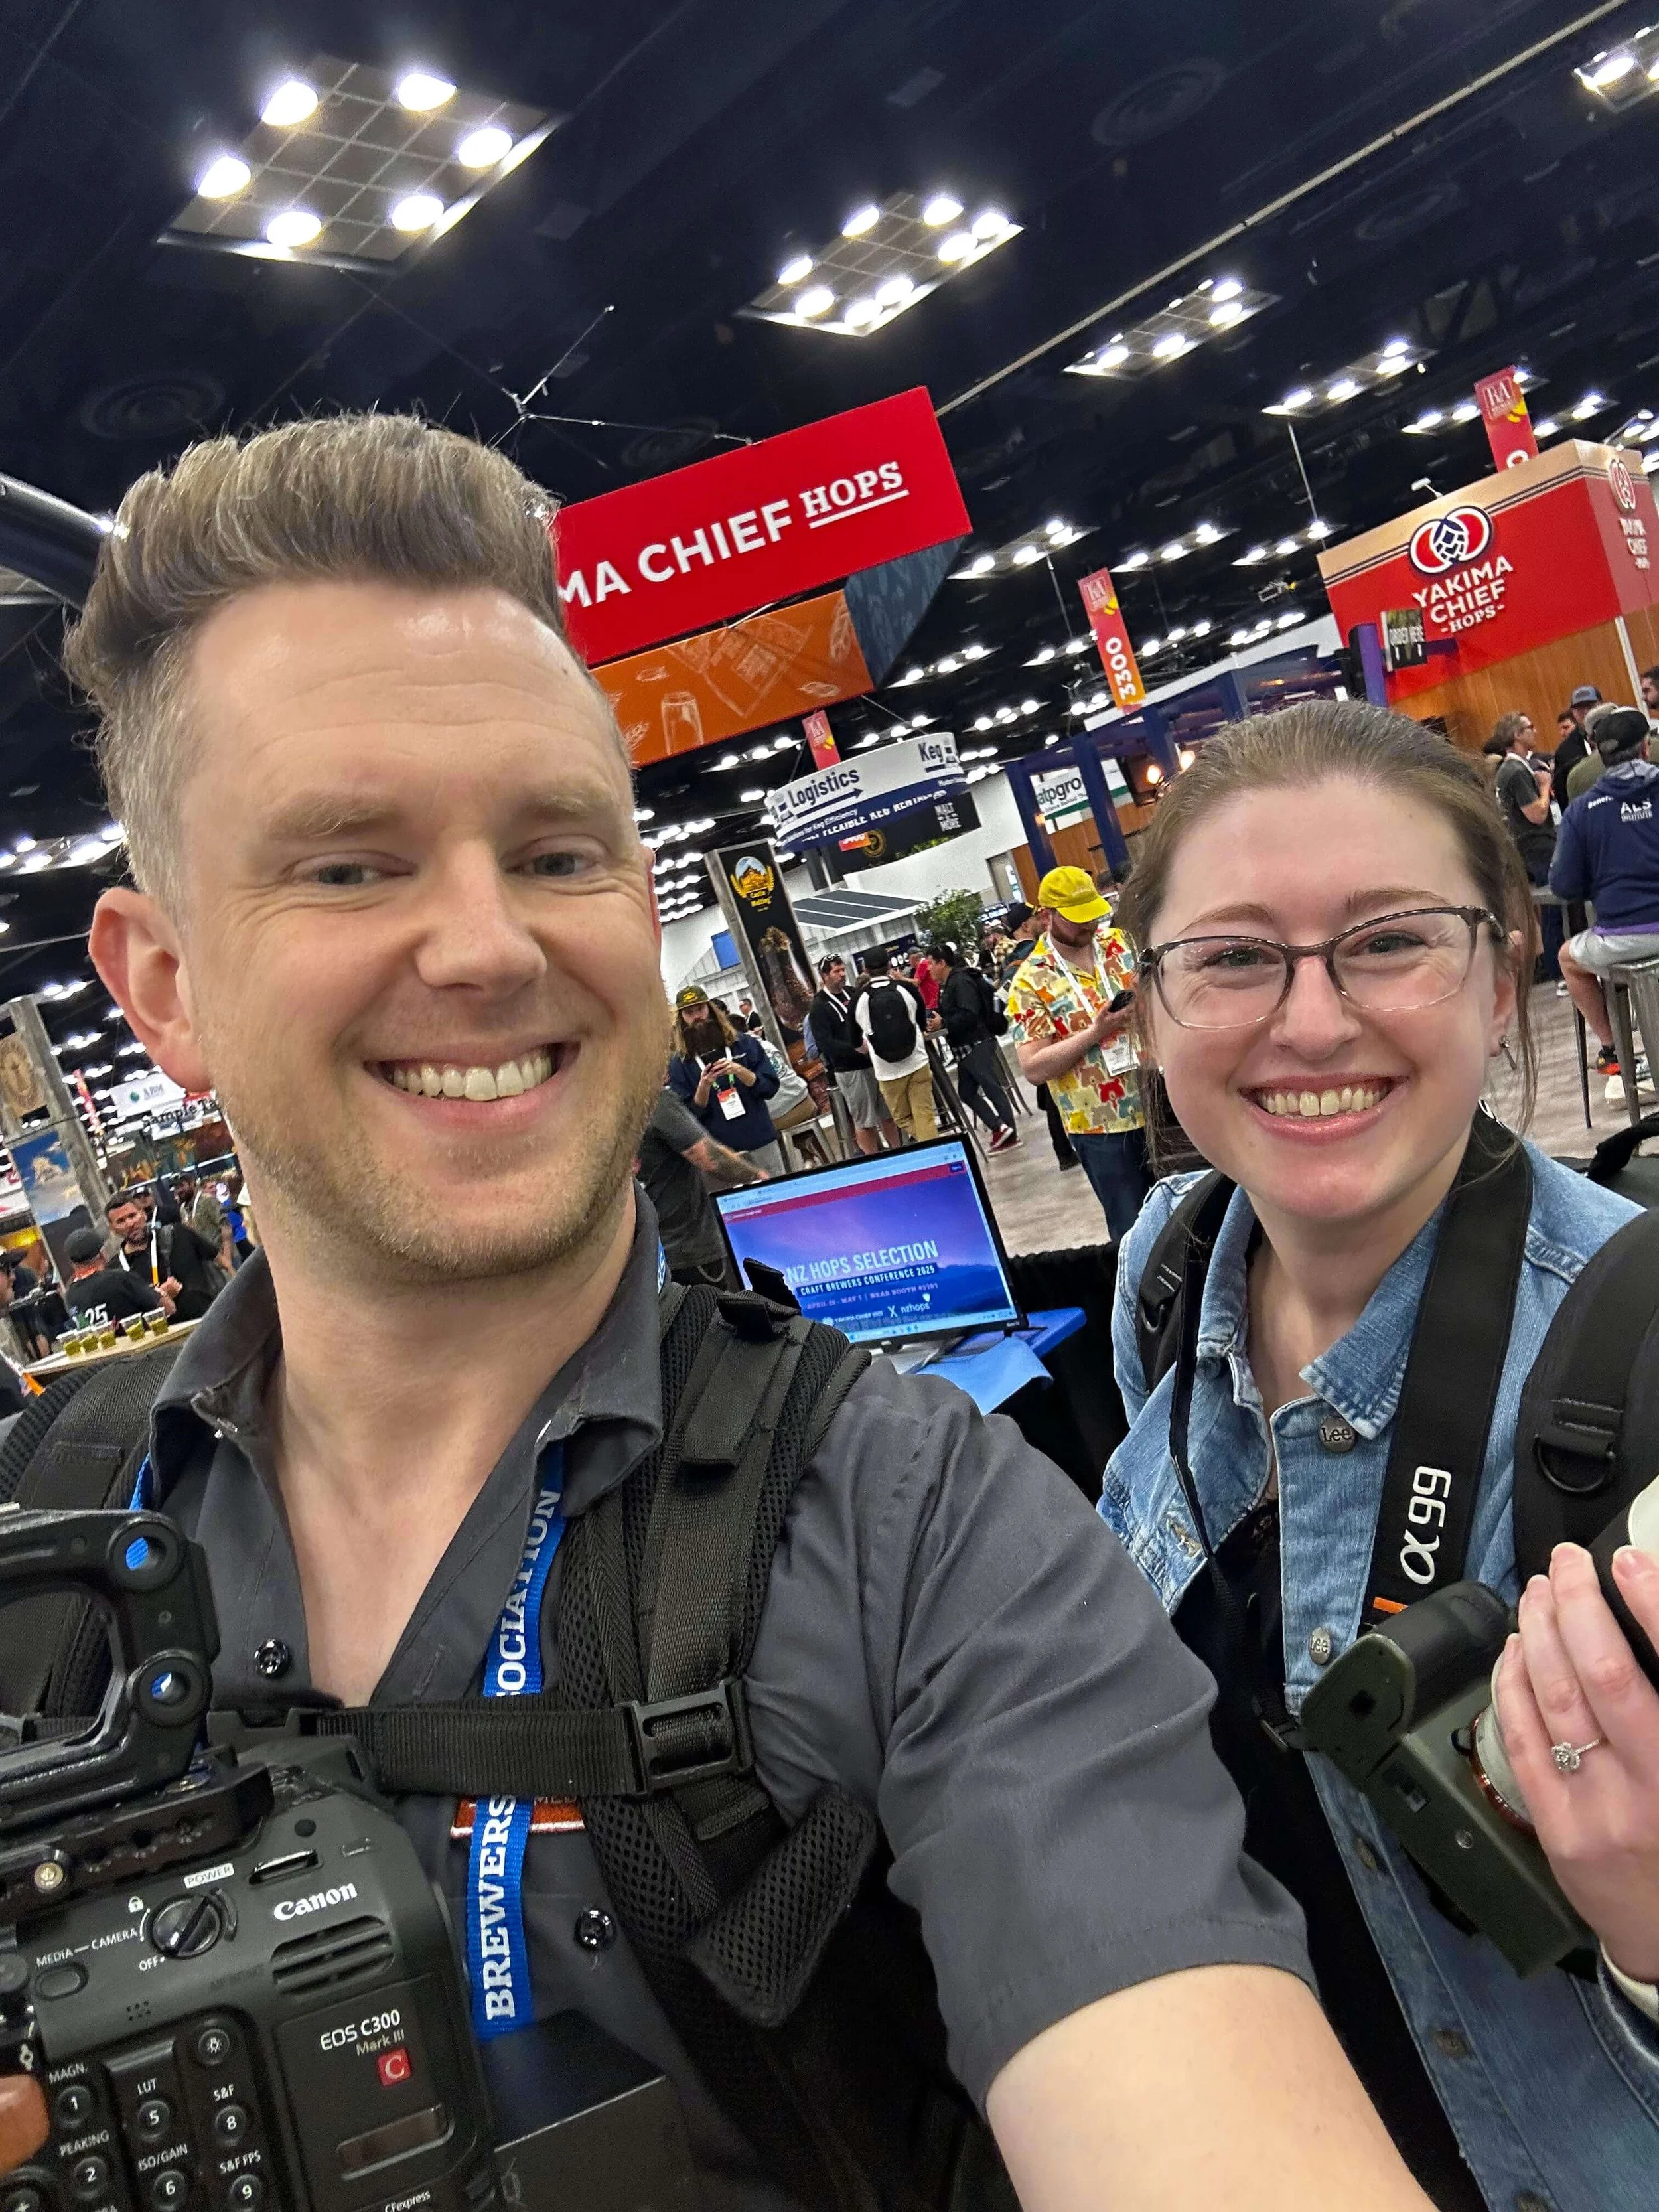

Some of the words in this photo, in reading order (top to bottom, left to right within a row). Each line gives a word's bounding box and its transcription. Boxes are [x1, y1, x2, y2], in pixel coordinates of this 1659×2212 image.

[638, 498, 792, 583] CHIEF
[800, 461, 904, 519] HOPS
[1411, 555, 1514, 608] YAKIMA
[1430, 578, 1506, 623] CHIEF
[1105, 636, 1137, 701] 3300
[918, 743, 944, 763] Keg
[788, 769, 860, 808] Logistics
[786, 1264, 809, 1283] NZ
[809, 1256, 851, 1279] HOPS
[851, 1240, 939, 1270] SELECTION
[800, 1284, 824, 1296] CRAFT
[826, 1278, 863, 1292] BREWERS
[863, 1268, 915, 1285] CONFERENCE
[916, 1264, 935, 1276] 2025
[900, 1303, 930, 1313] nzhops
[1321, 1427, 1352, 1443] Lee
[1311, 1635, 1329, 1653] Lee
[478, 1794, 516, 2021] BREWERS
[497, 1490, 561, 1697] OCIATION
[186, 1865, 232, 1887] POWER
[273, 1883, 358, 1921] Canon
[36, 1949, 73, 1968] MEDIA
[91, 1928, 137, 1951] CAMERA
[139, 1956, 159, 1972] OFF
[320, 2024, 358, 2051] EOS
[360, 2009, 401, 2036] C300
[356, 2035, 392, 2056] Mark
[137, 2078, 157, 2095] LUT
[213, 2084, 235, 2102] S&F
[70, 2097, 78, 2110] 1
[149, 2110, 159, 2125] 5
[226, 2116, 237, 2130] 8
[59, 2130, 110, 2157] PEAKING
[137, 2144, 188, 2171] ISO/GAIN
[220, 2158, 240, 2174] S&F
[242, 2150, 261, 2167] FPS
[86, 2168, 96, 2182] 2
[165, 2180, 176, 2195] 6
[242, 2184, 252, 2199] 9
[384, 2191, 431, 2212] CFexpress
